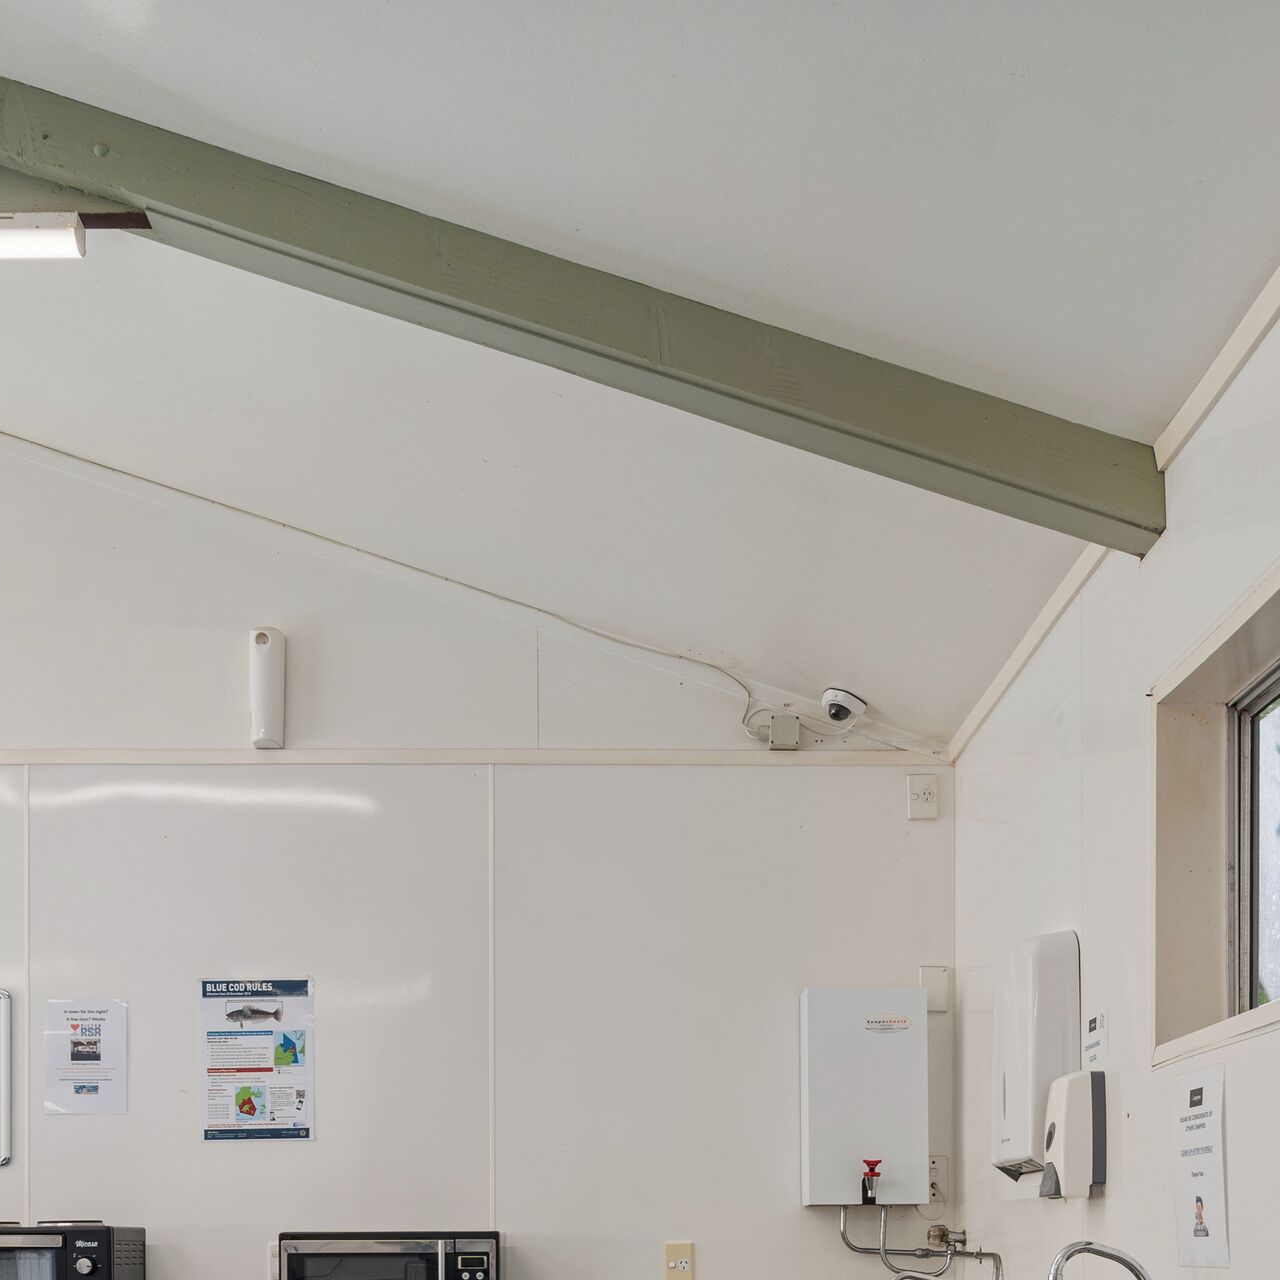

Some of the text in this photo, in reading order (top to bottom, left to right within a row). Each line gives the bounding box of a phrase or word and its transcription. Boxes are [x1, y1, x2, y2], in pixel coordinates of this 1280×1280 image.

[206, 982, 273, 991] BLUE COD RULES
[81, 1027, 101, 1037] RSA
